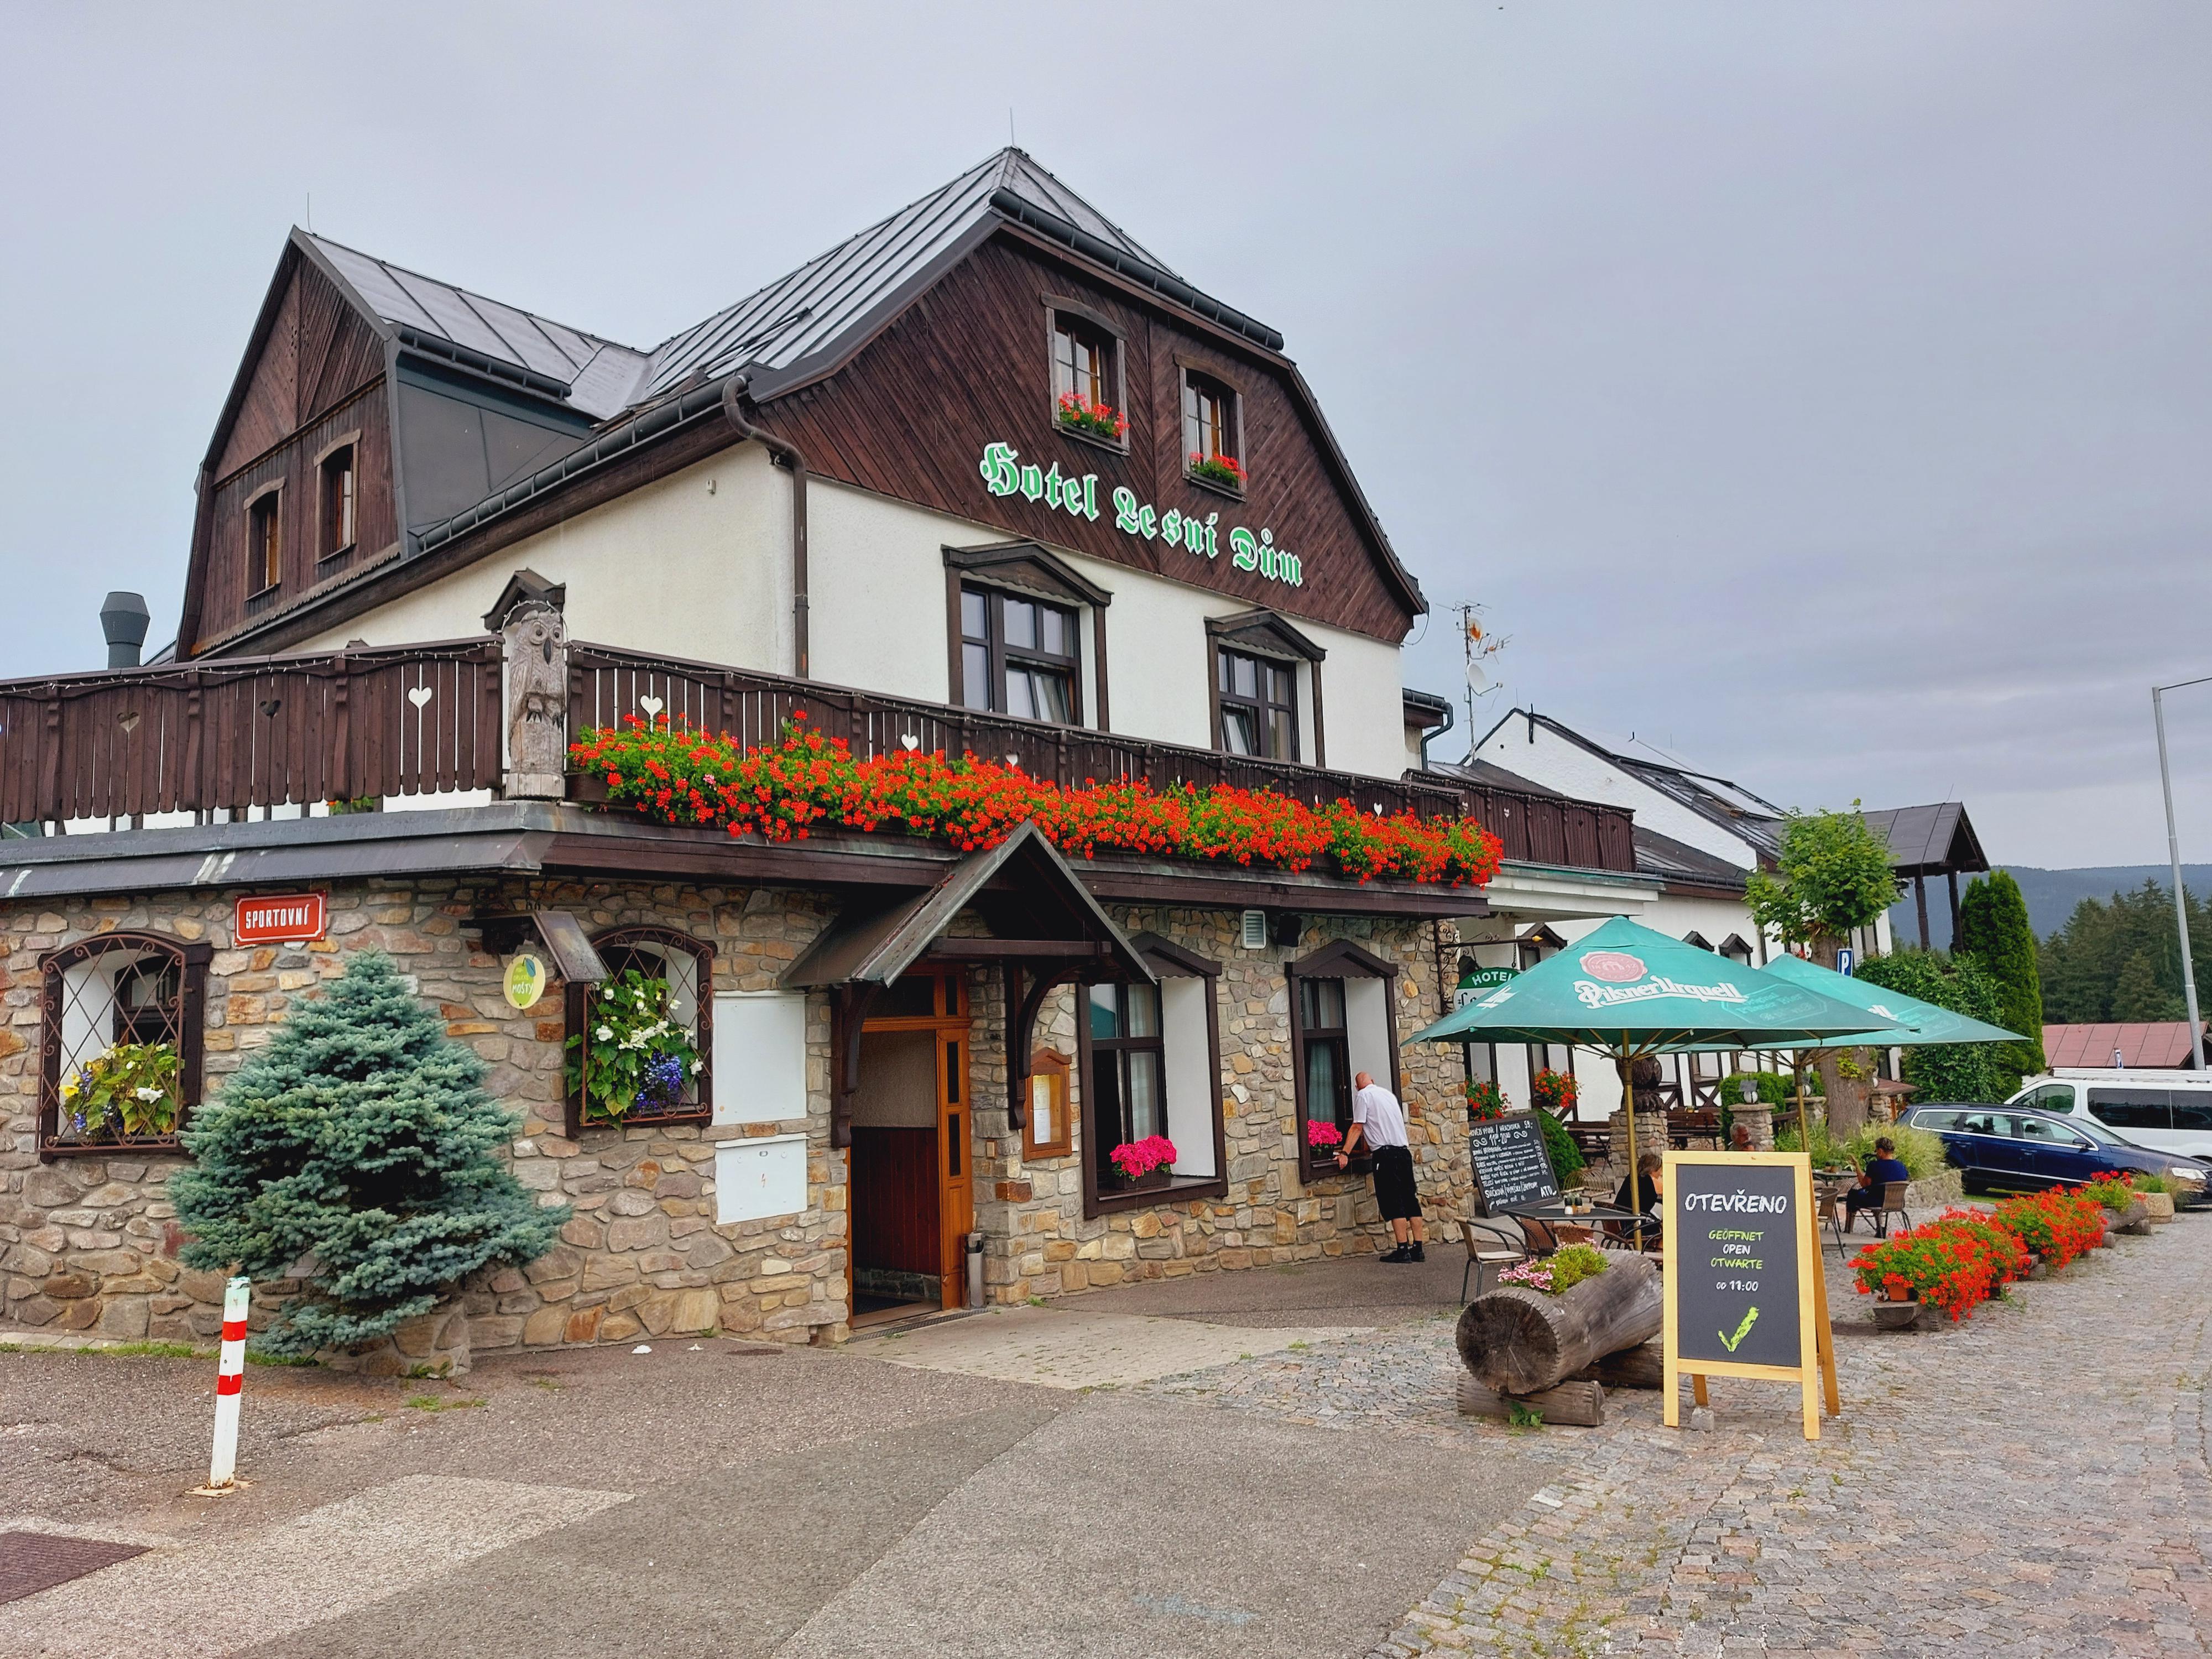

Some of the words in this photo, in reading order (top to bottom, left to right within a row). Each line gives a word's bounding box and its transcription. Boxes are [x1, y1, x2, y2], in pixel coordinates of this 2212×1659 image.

[979, 441, 1099, 521] Hotel
[1112, 486, 1219, 559] Lesní
[1229, 526, 1302, 587] Dům
[245, 903, 310, 930] SPORTOVNÍ
[1841, 952, 1849, 975] P
[1573, 980, 1659, 1009] Pilsner
[1650, 975, 1747, 1003] Urquell
[1684, 1189, 1787, 1214] OTEVŘENO
[1708, 1228, 1764, 1242] GEÖFFNET
[1723, 1243, 1751, 1256] OPEN
[1710, 1257, 1763, 1270] OTWARTE
[1729, 1280, 1759, 1292] 11:00
